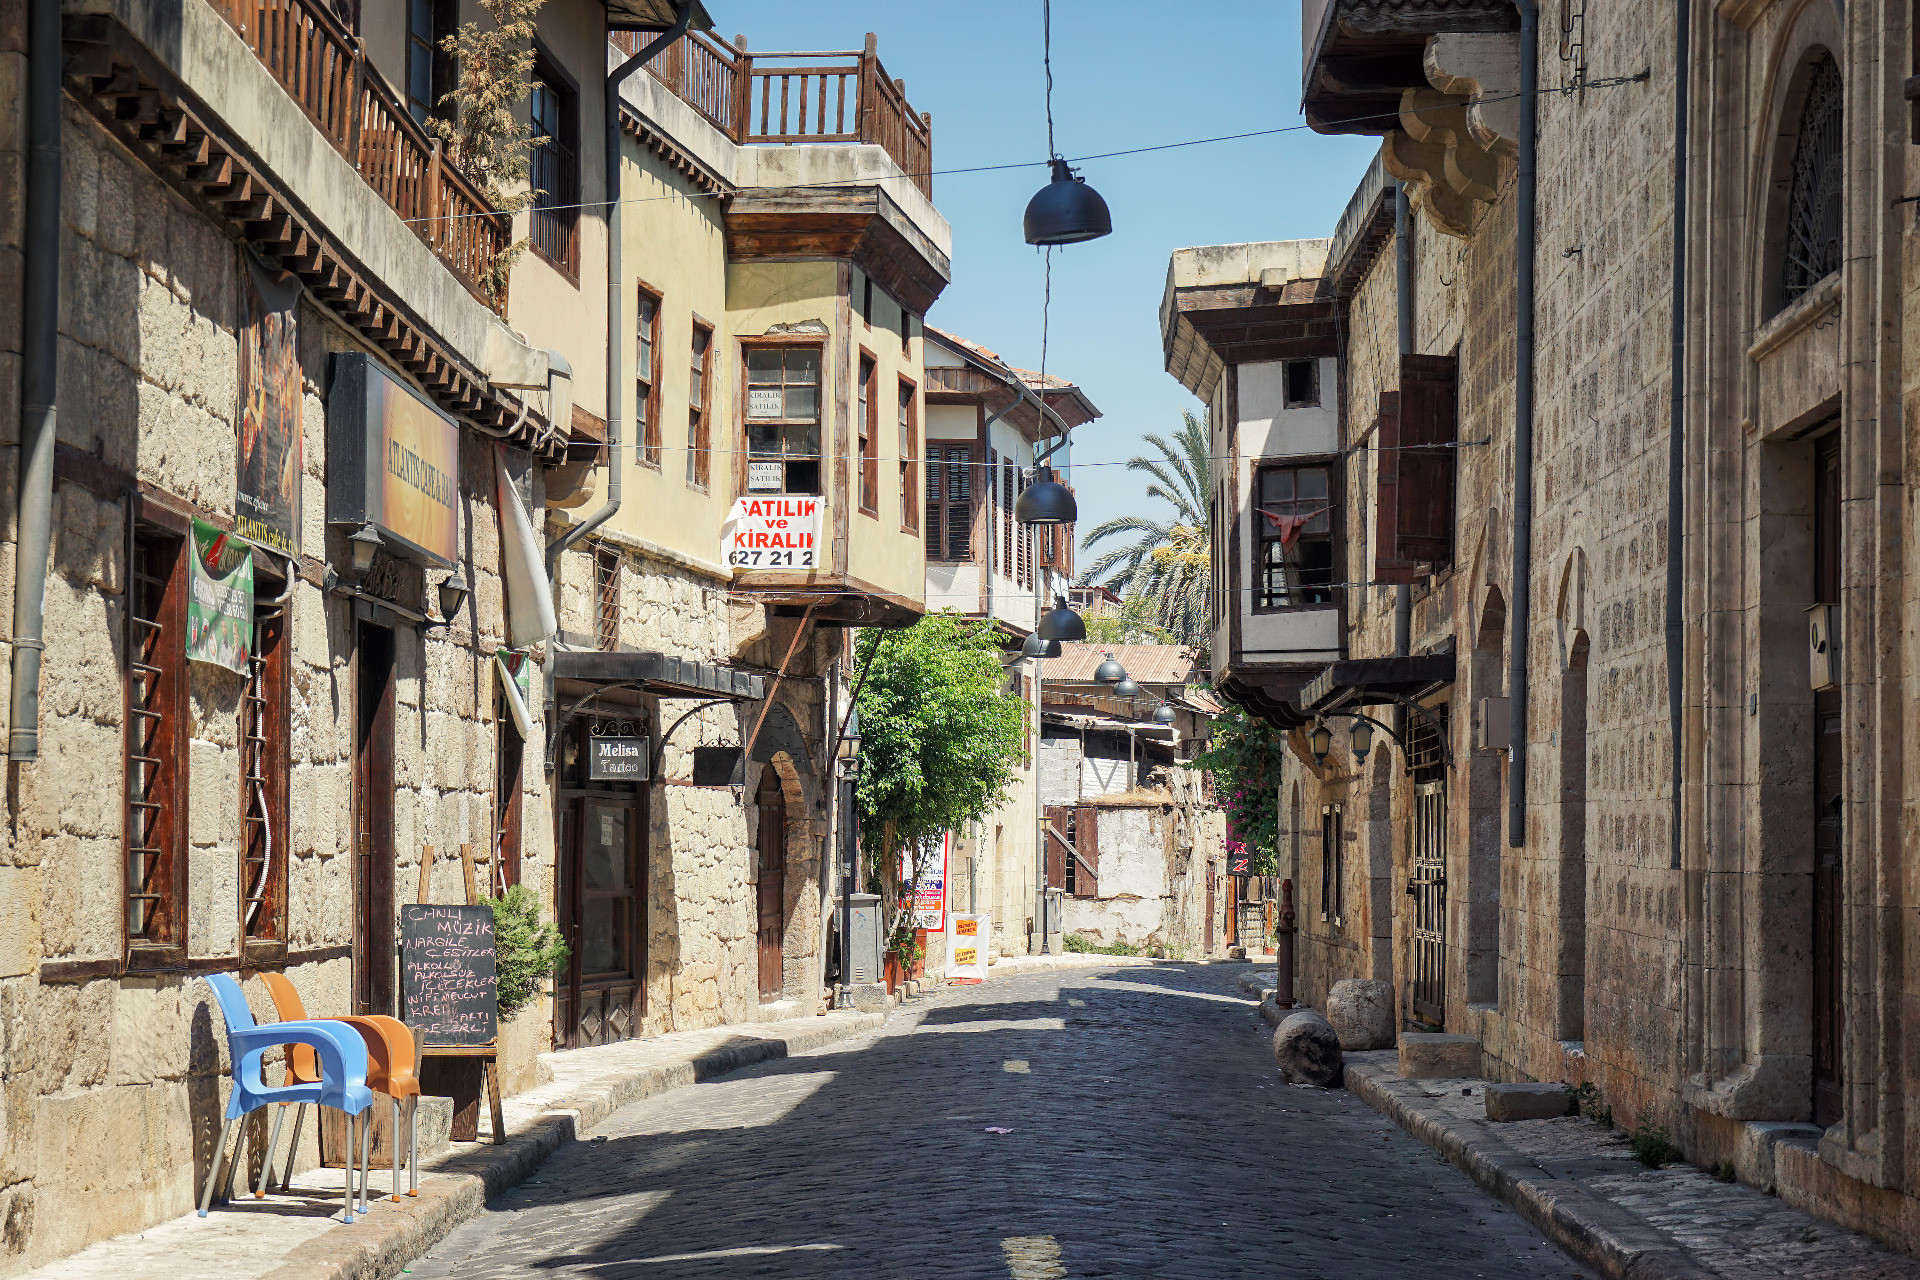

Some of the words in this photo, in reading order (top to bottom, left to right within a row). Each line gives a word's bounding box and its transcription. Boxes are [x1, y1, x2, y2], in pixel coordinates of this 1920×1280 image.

[764, 519, 788, 529] ve
[728, 551, 762, 566] 627
[769, 551, 793, 566] 21
[598, 742, 640, 757] Melisa
[408, 907, 462, 920] CANLI
[437, 919, 494, 936] MÜZİK
[406, 934, 468, 950] NARGİLE
